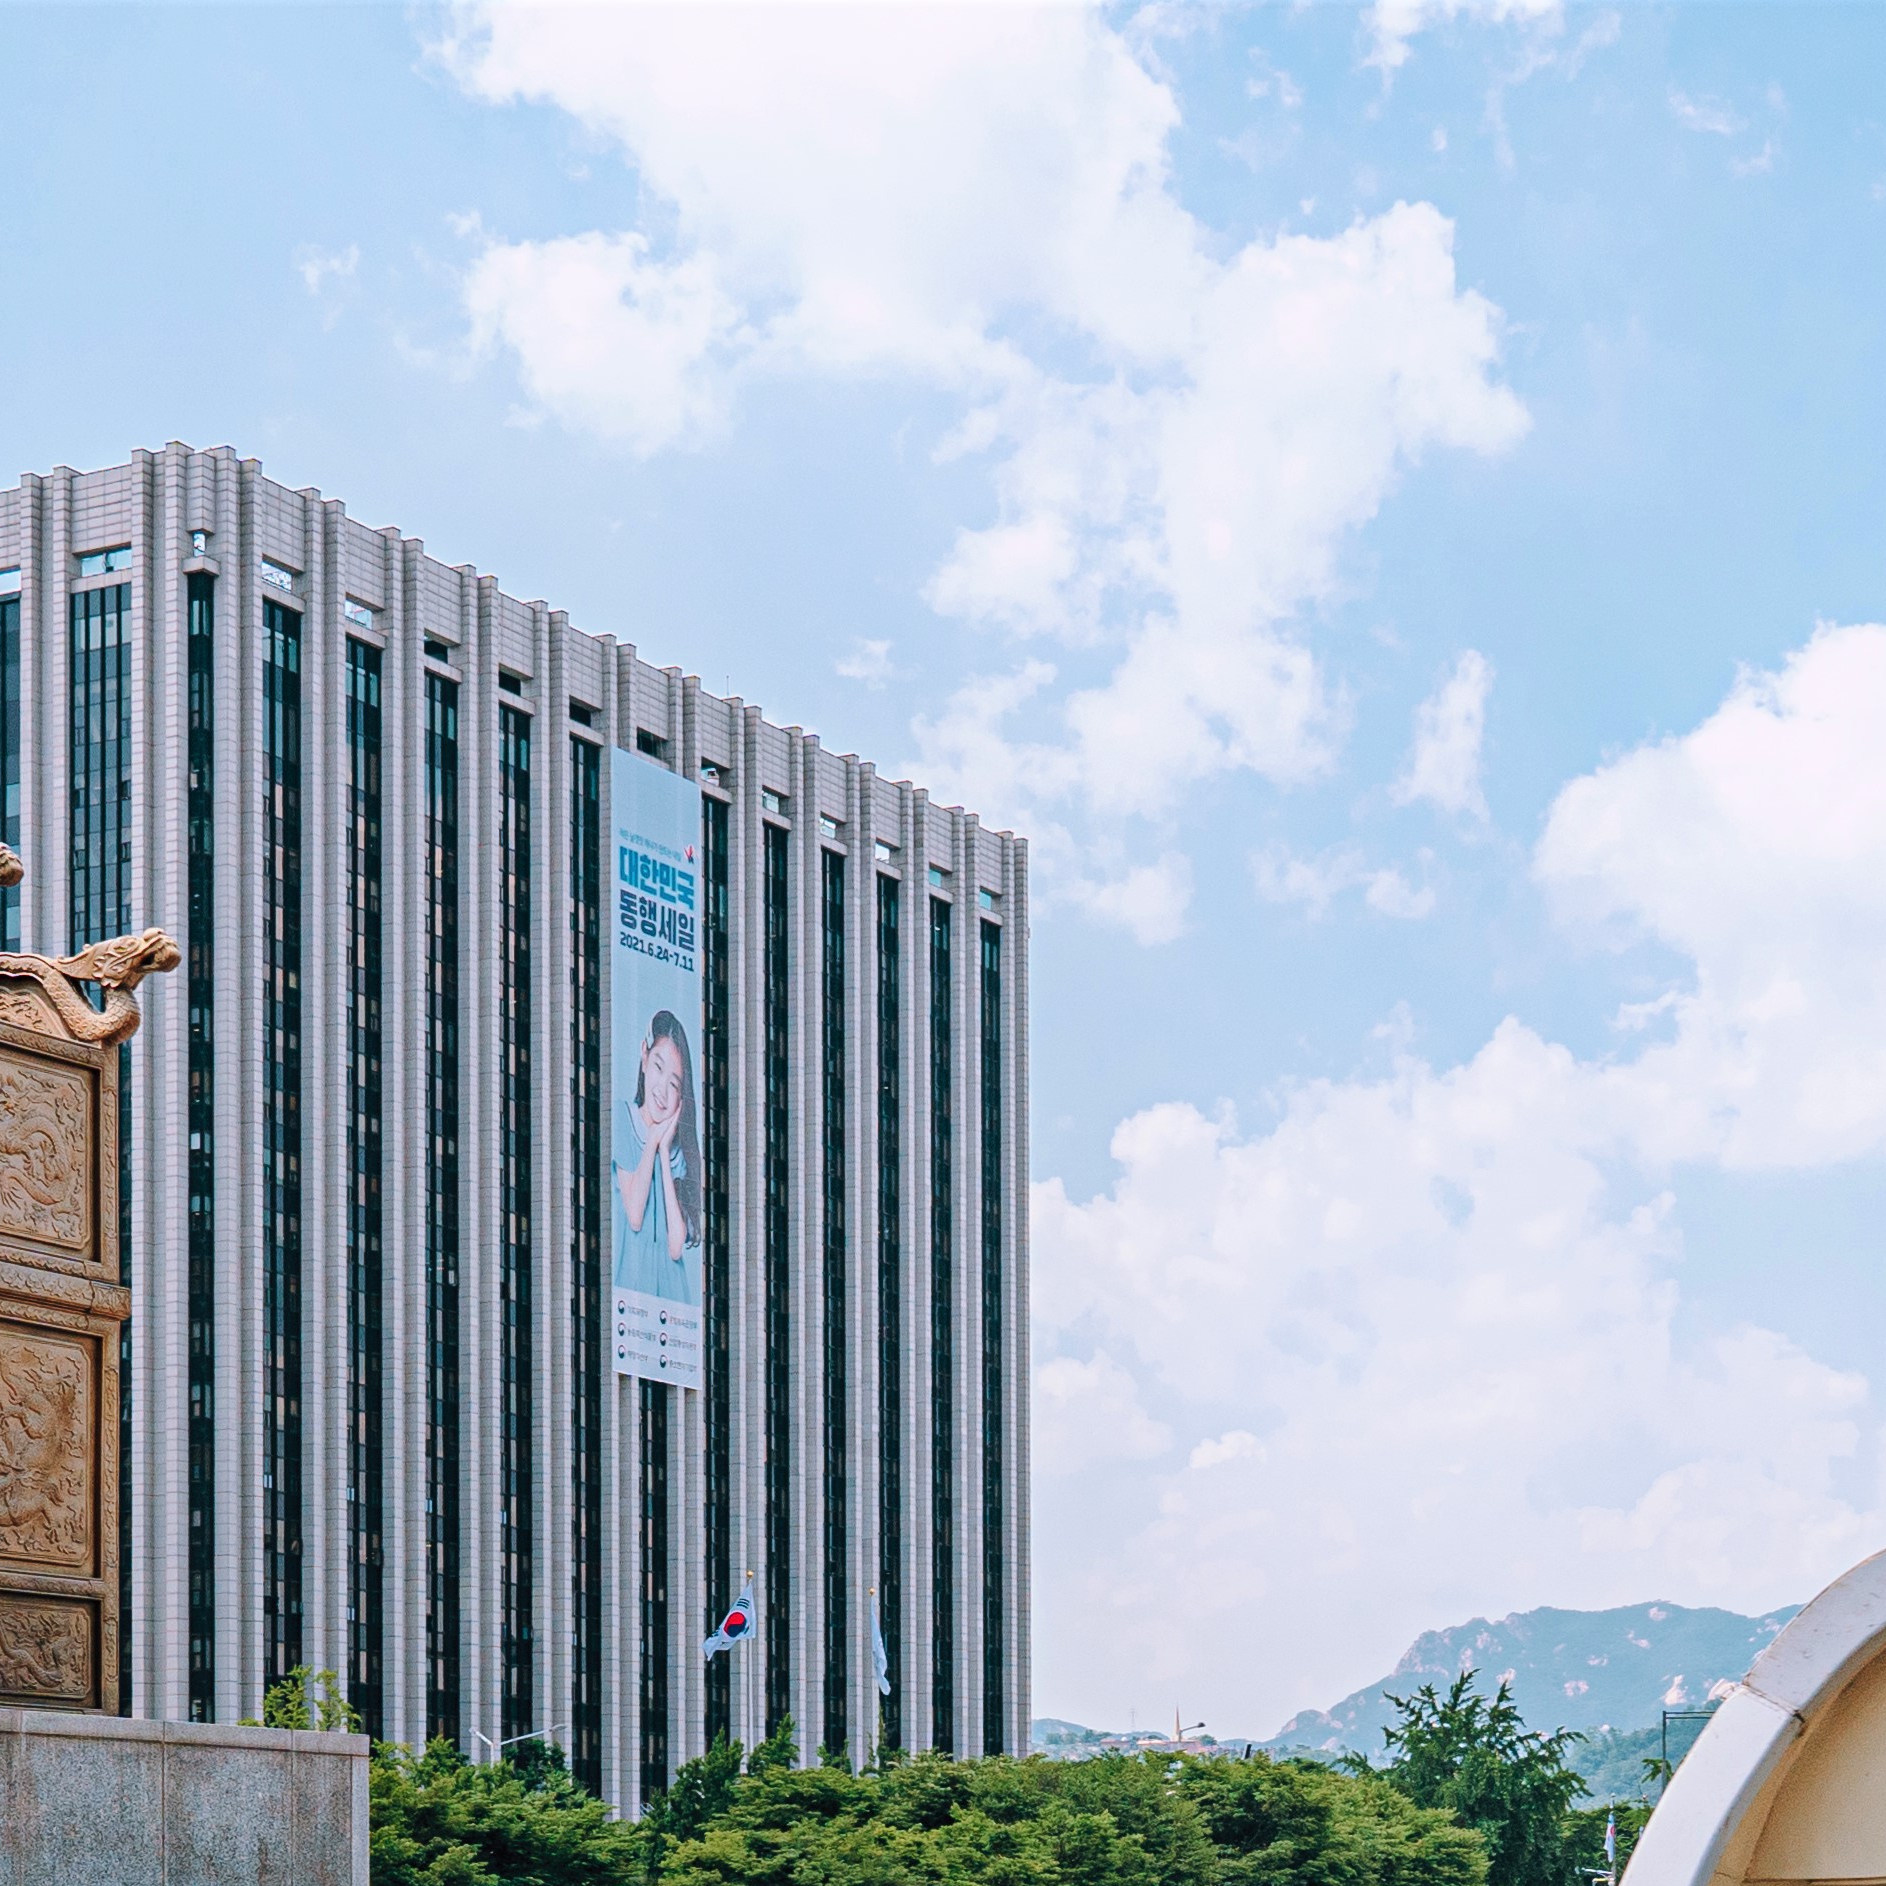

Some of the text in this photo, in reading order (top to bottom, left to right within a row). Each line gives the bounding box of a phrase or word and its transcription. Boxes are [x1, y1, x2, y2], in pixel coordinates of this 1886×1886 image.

[619, 845, 695, 912] 대한민국
[619, 888, 695, 953] 동행세일
[619, 931, 695, 973] 2021.6.24-7.11
